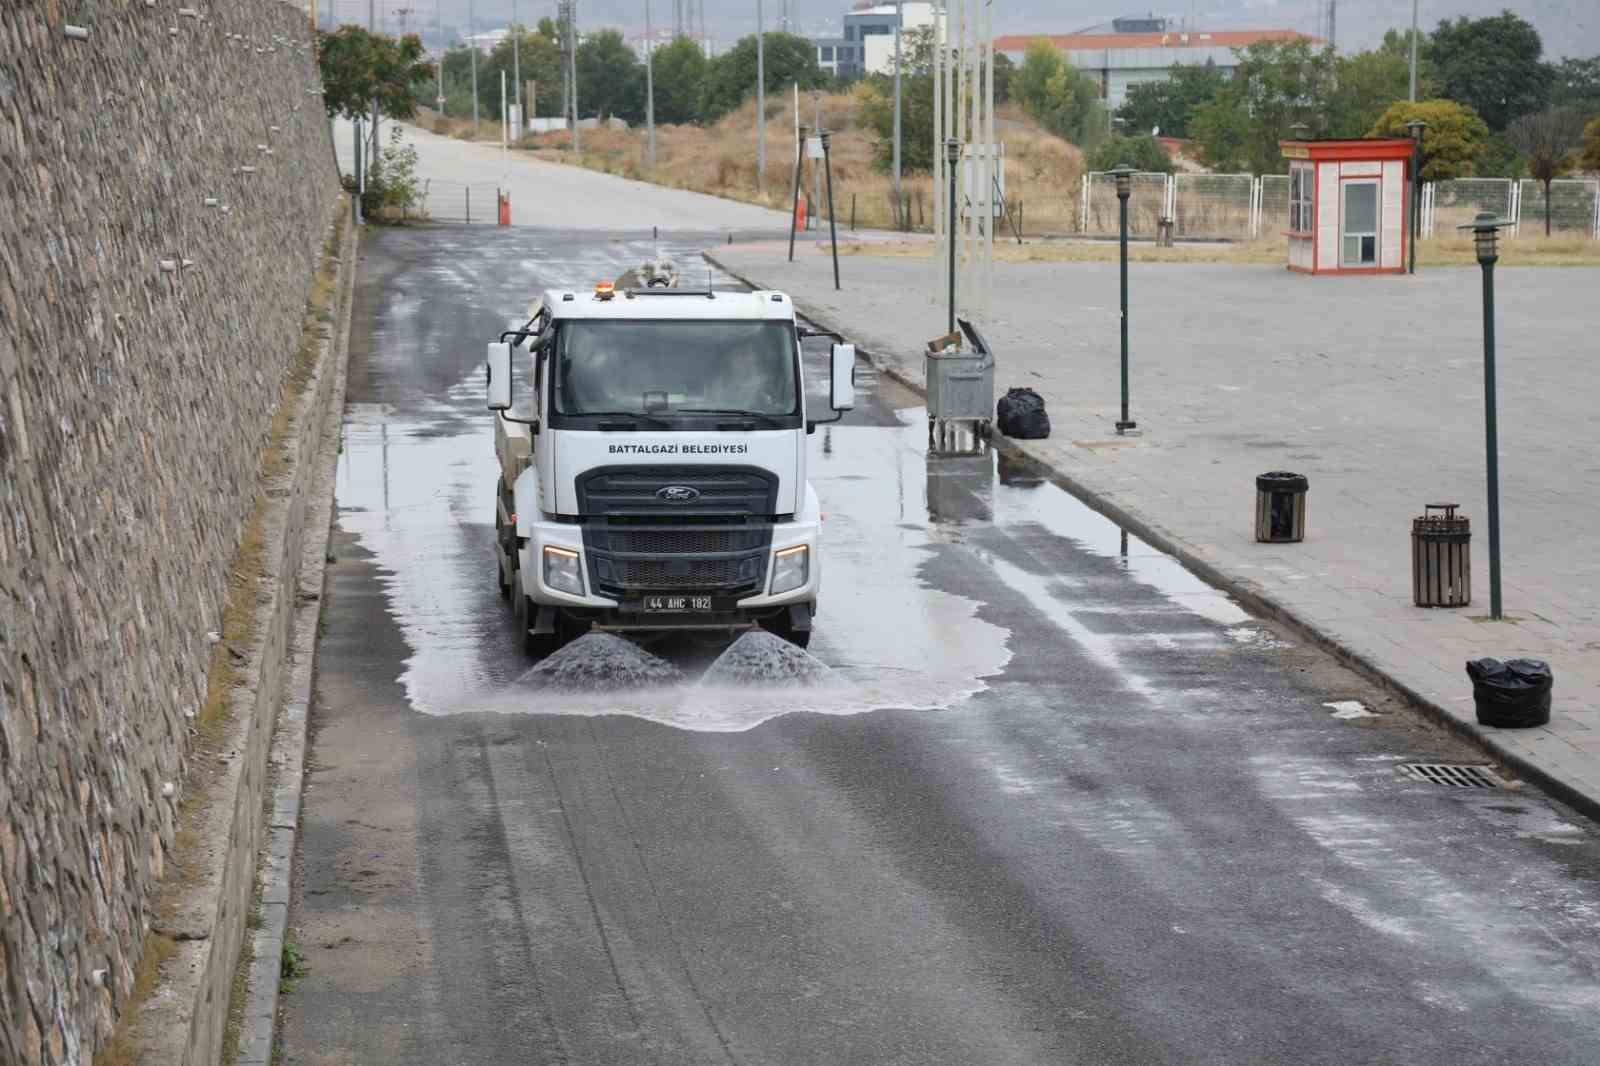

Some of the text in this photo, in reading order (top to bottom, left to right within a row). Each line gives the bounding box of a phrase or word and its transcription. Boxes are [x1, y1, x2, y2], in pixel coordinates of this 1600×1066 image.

[609, 444, 748, 454] BATTALGAZİ BELEDİYESİ
[650, 598, 662, 609] 44
[667, 598, 686, 609] AHC
